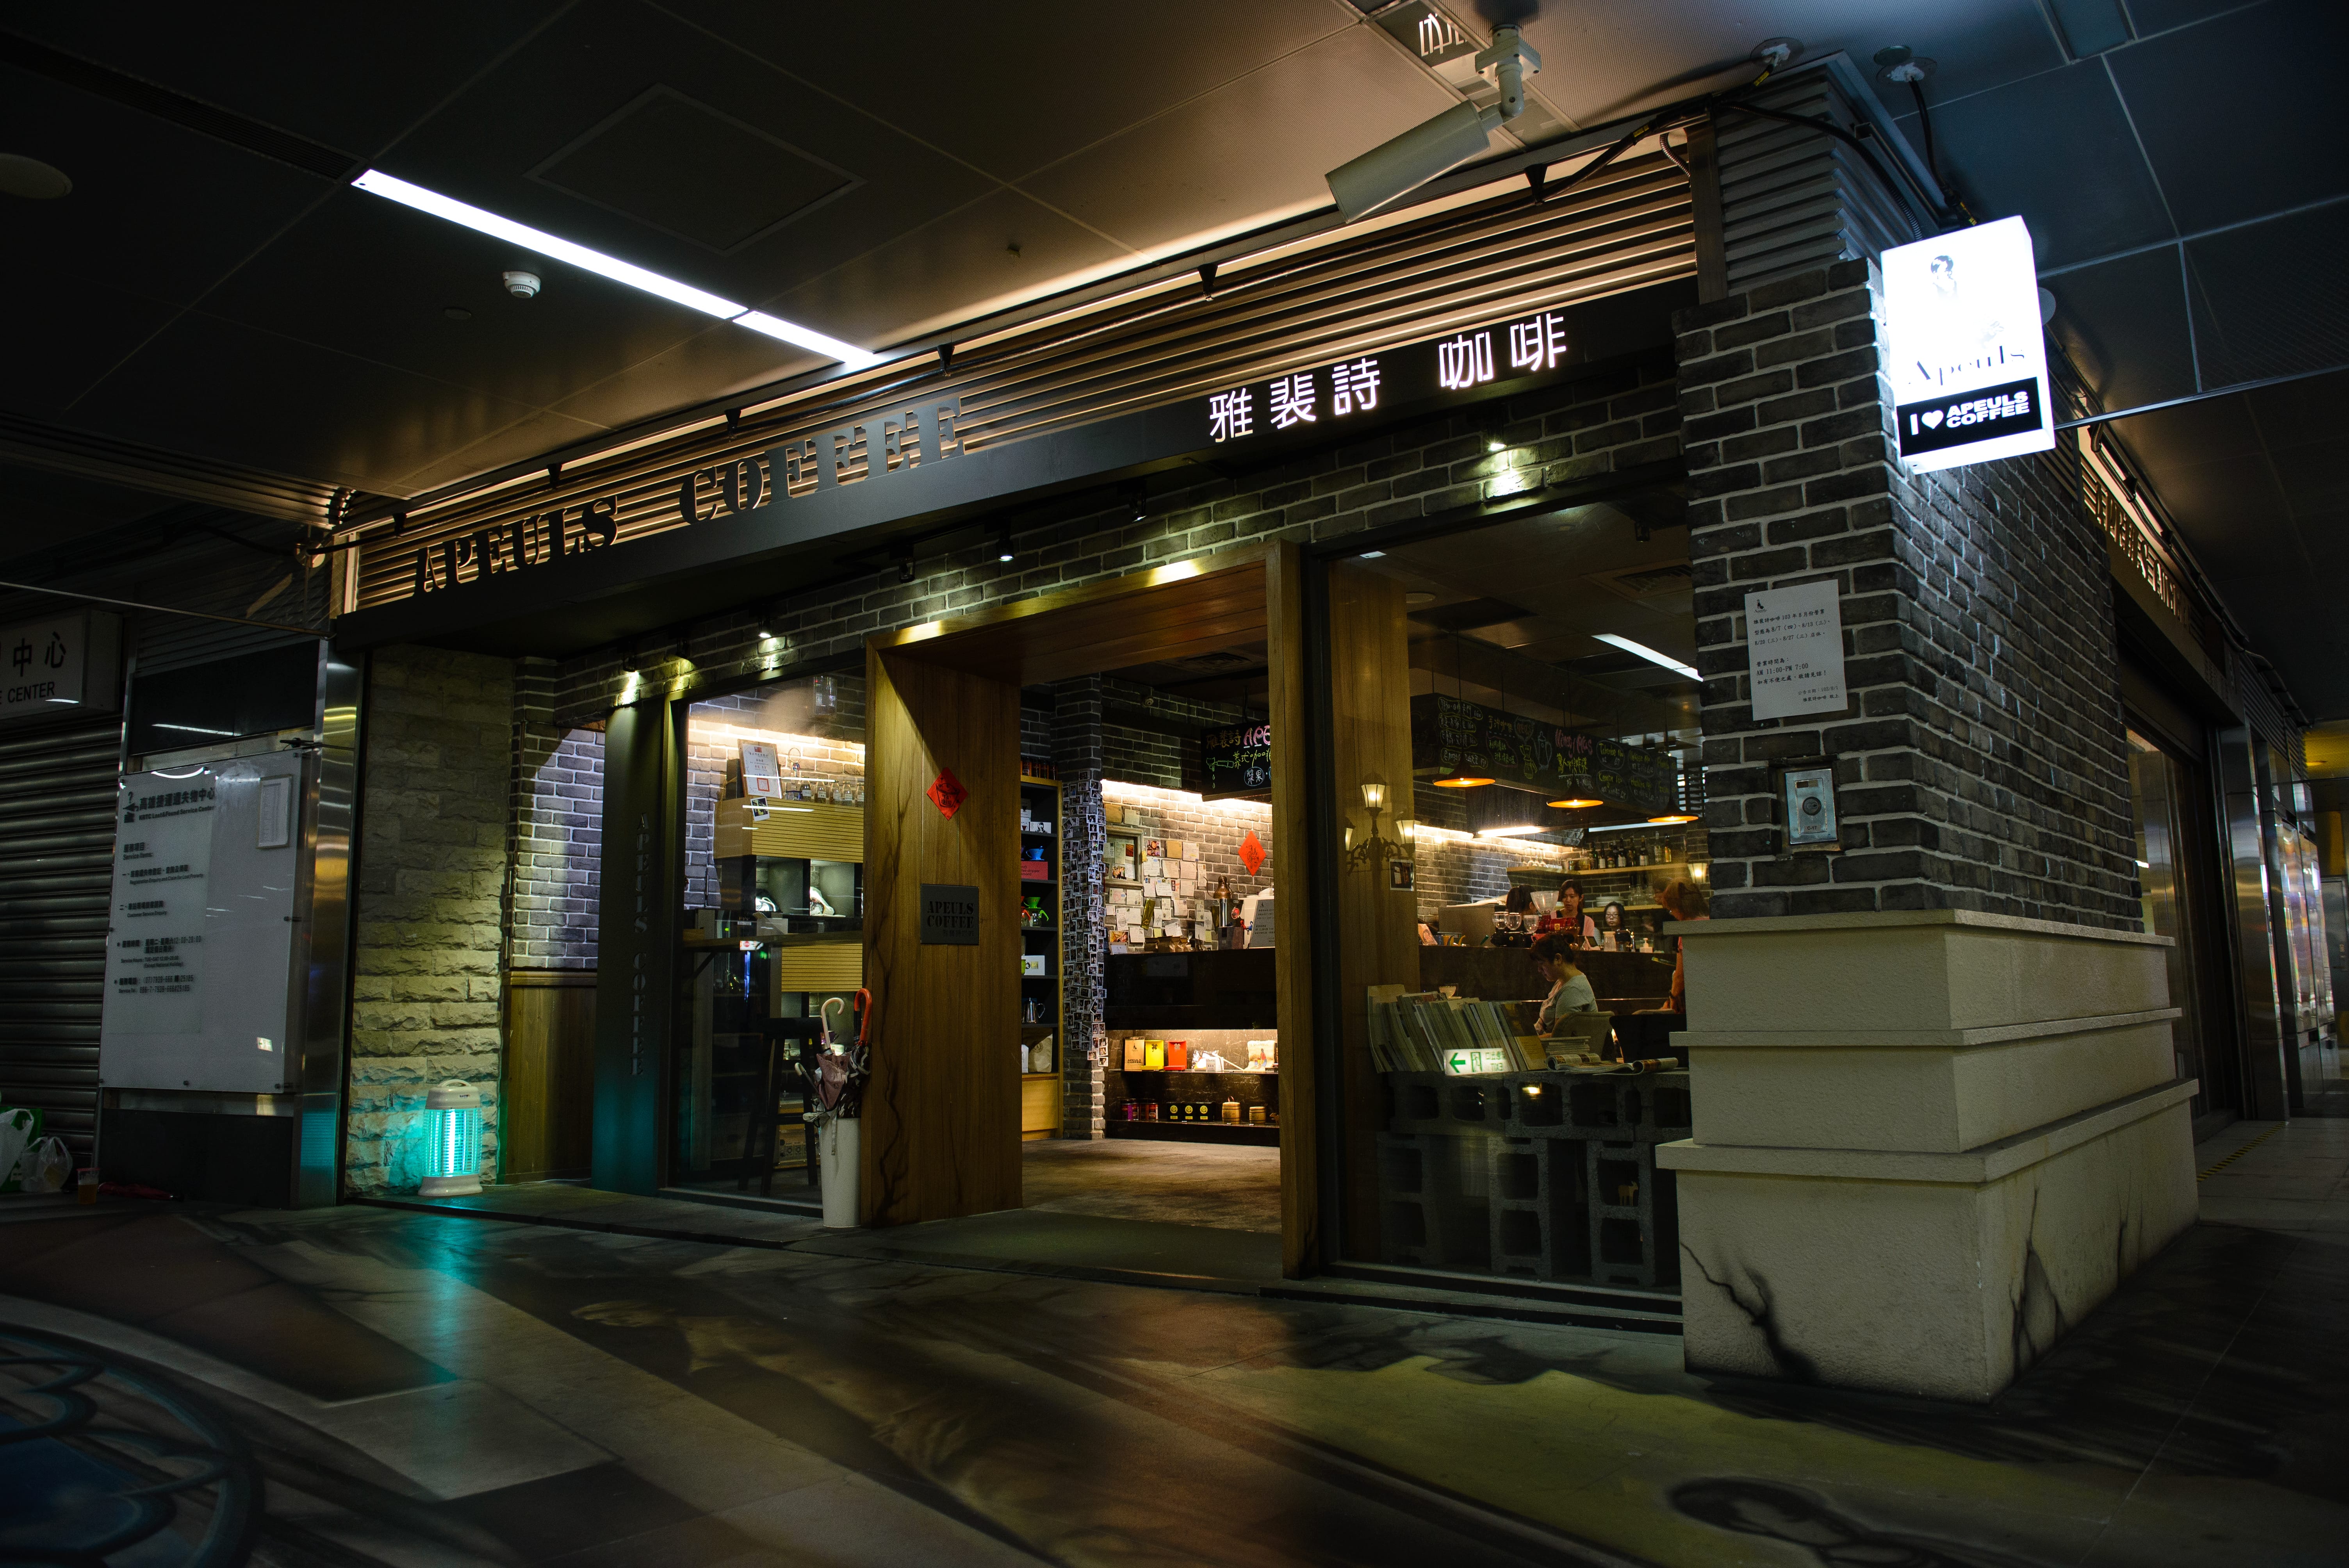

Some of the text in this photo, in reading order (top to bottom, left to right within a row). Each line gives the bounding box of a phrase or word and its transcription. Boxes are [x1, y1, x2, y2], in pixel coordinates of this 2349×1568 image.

[1209, 313, 1567, 444] 雅裴詩 咖啡
[1910, 391, 2028, 436] I APEULS
[1946, 402, 2030, 429] COFFEE
[414, 396, 965, 596] APEULS COFFEE
[13, 631, 66, 677] 中心
[7, 681, 55, 703] CENTER
[927, 901, 974, 914] APEULS
[927, 915, 973, 928] COFFEE
[630, 812, 649, 1075] APEULS COFFEE
